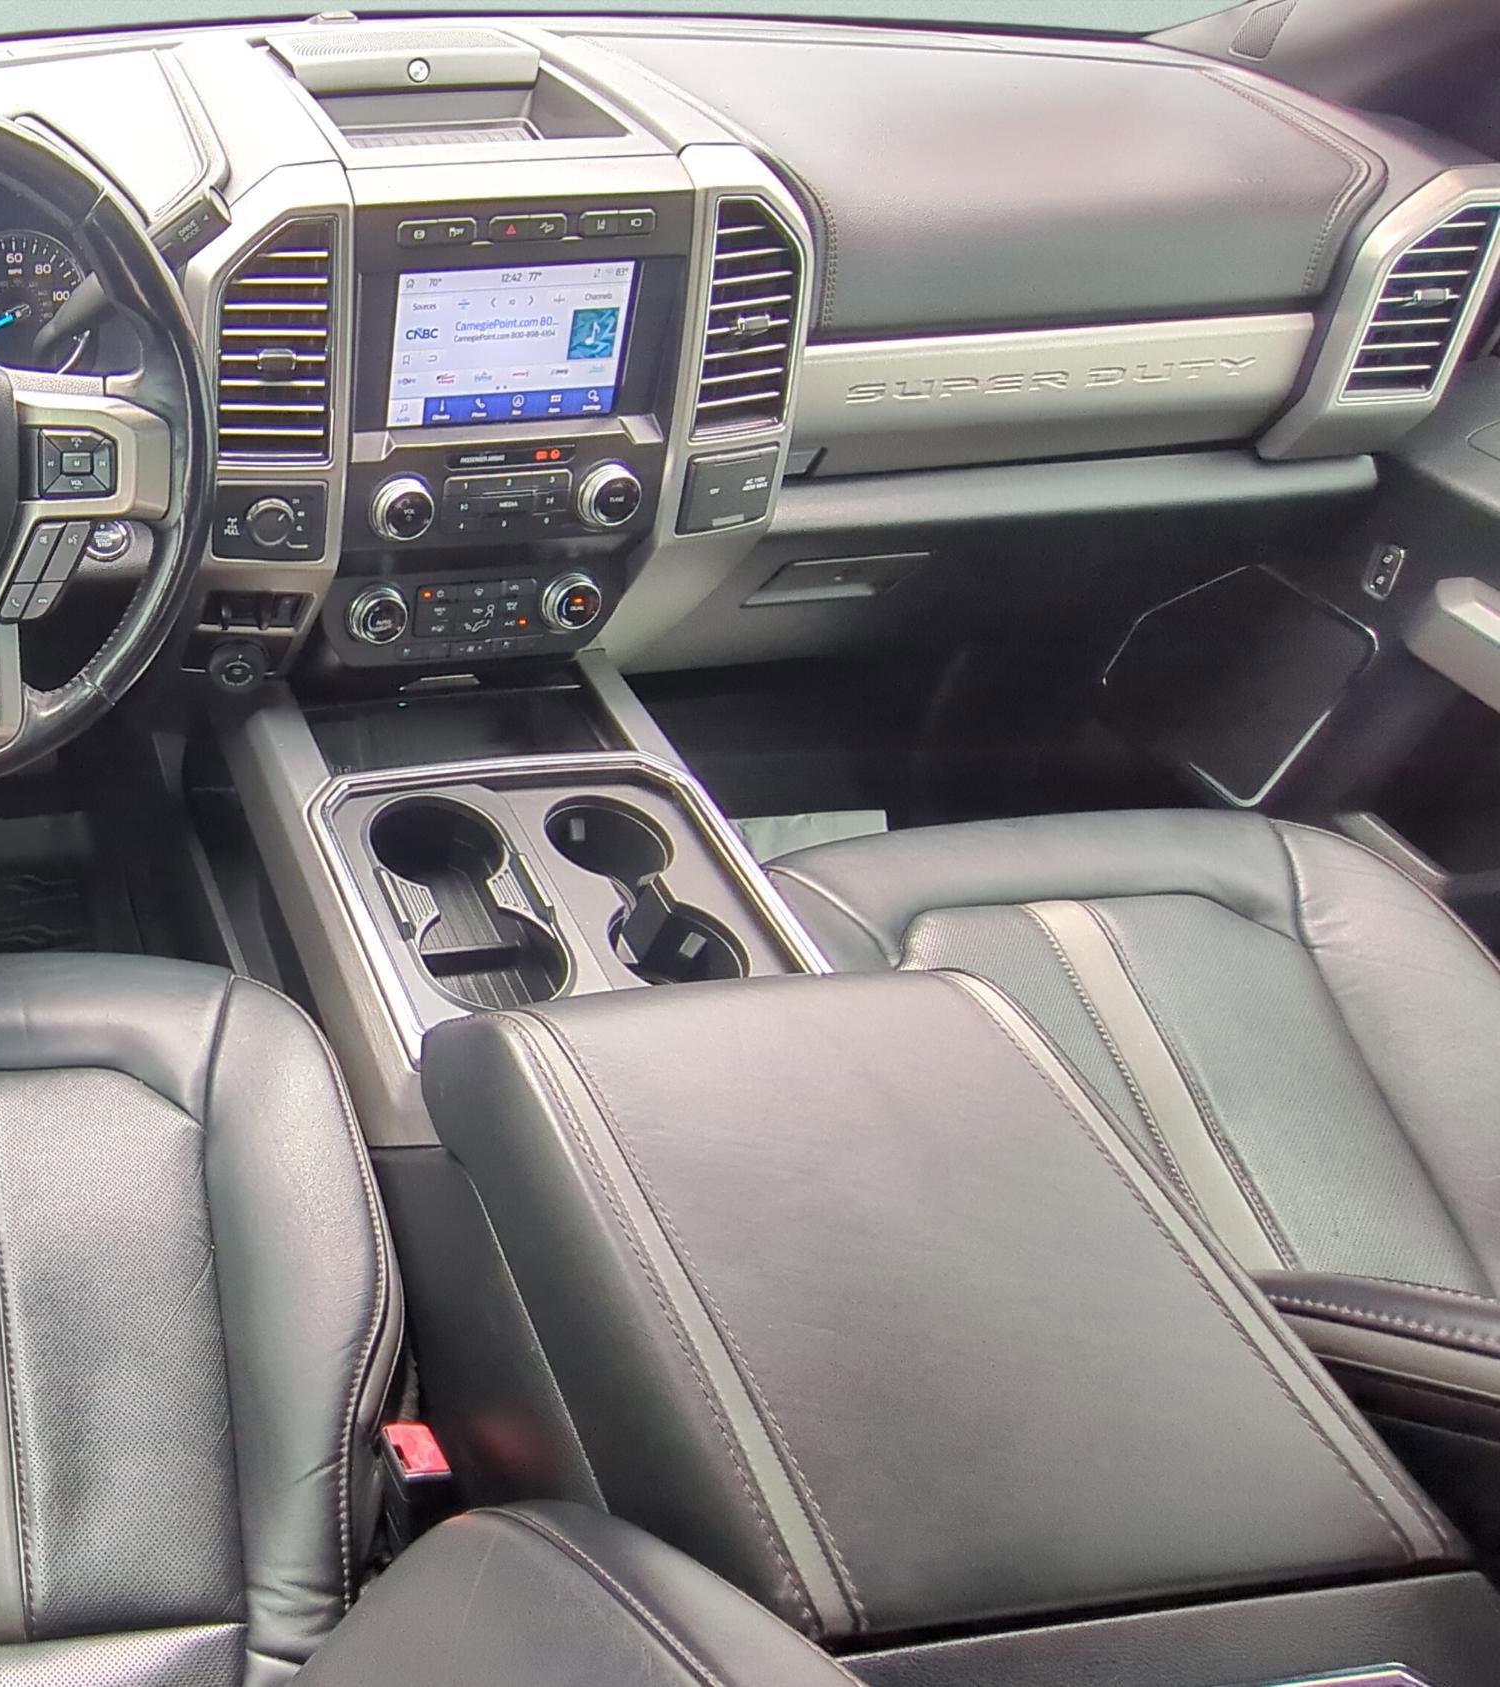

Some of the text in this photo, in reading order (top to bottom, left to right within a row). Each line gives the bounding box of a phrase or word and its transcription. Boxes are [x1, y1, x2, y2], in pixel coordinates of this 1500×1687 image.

[178, 219, 197, 237] DRIVE
[6, 253, 23, 264] 60
[35, 264, 51, 275] 80
[501, 273, 522, 283] 12:42
[52, 291, 70, 301] 100
[585, 293, 612, 301] Channels
[412, 303, 437, 311] Sources
[455, 318, 538, 332] CarnegiePoint.com
[405, 328, 439, 340] CNBC
[845, 356, 1257, 404] SUPER DUTY
[499, 500, 518, 508] MEDIA
